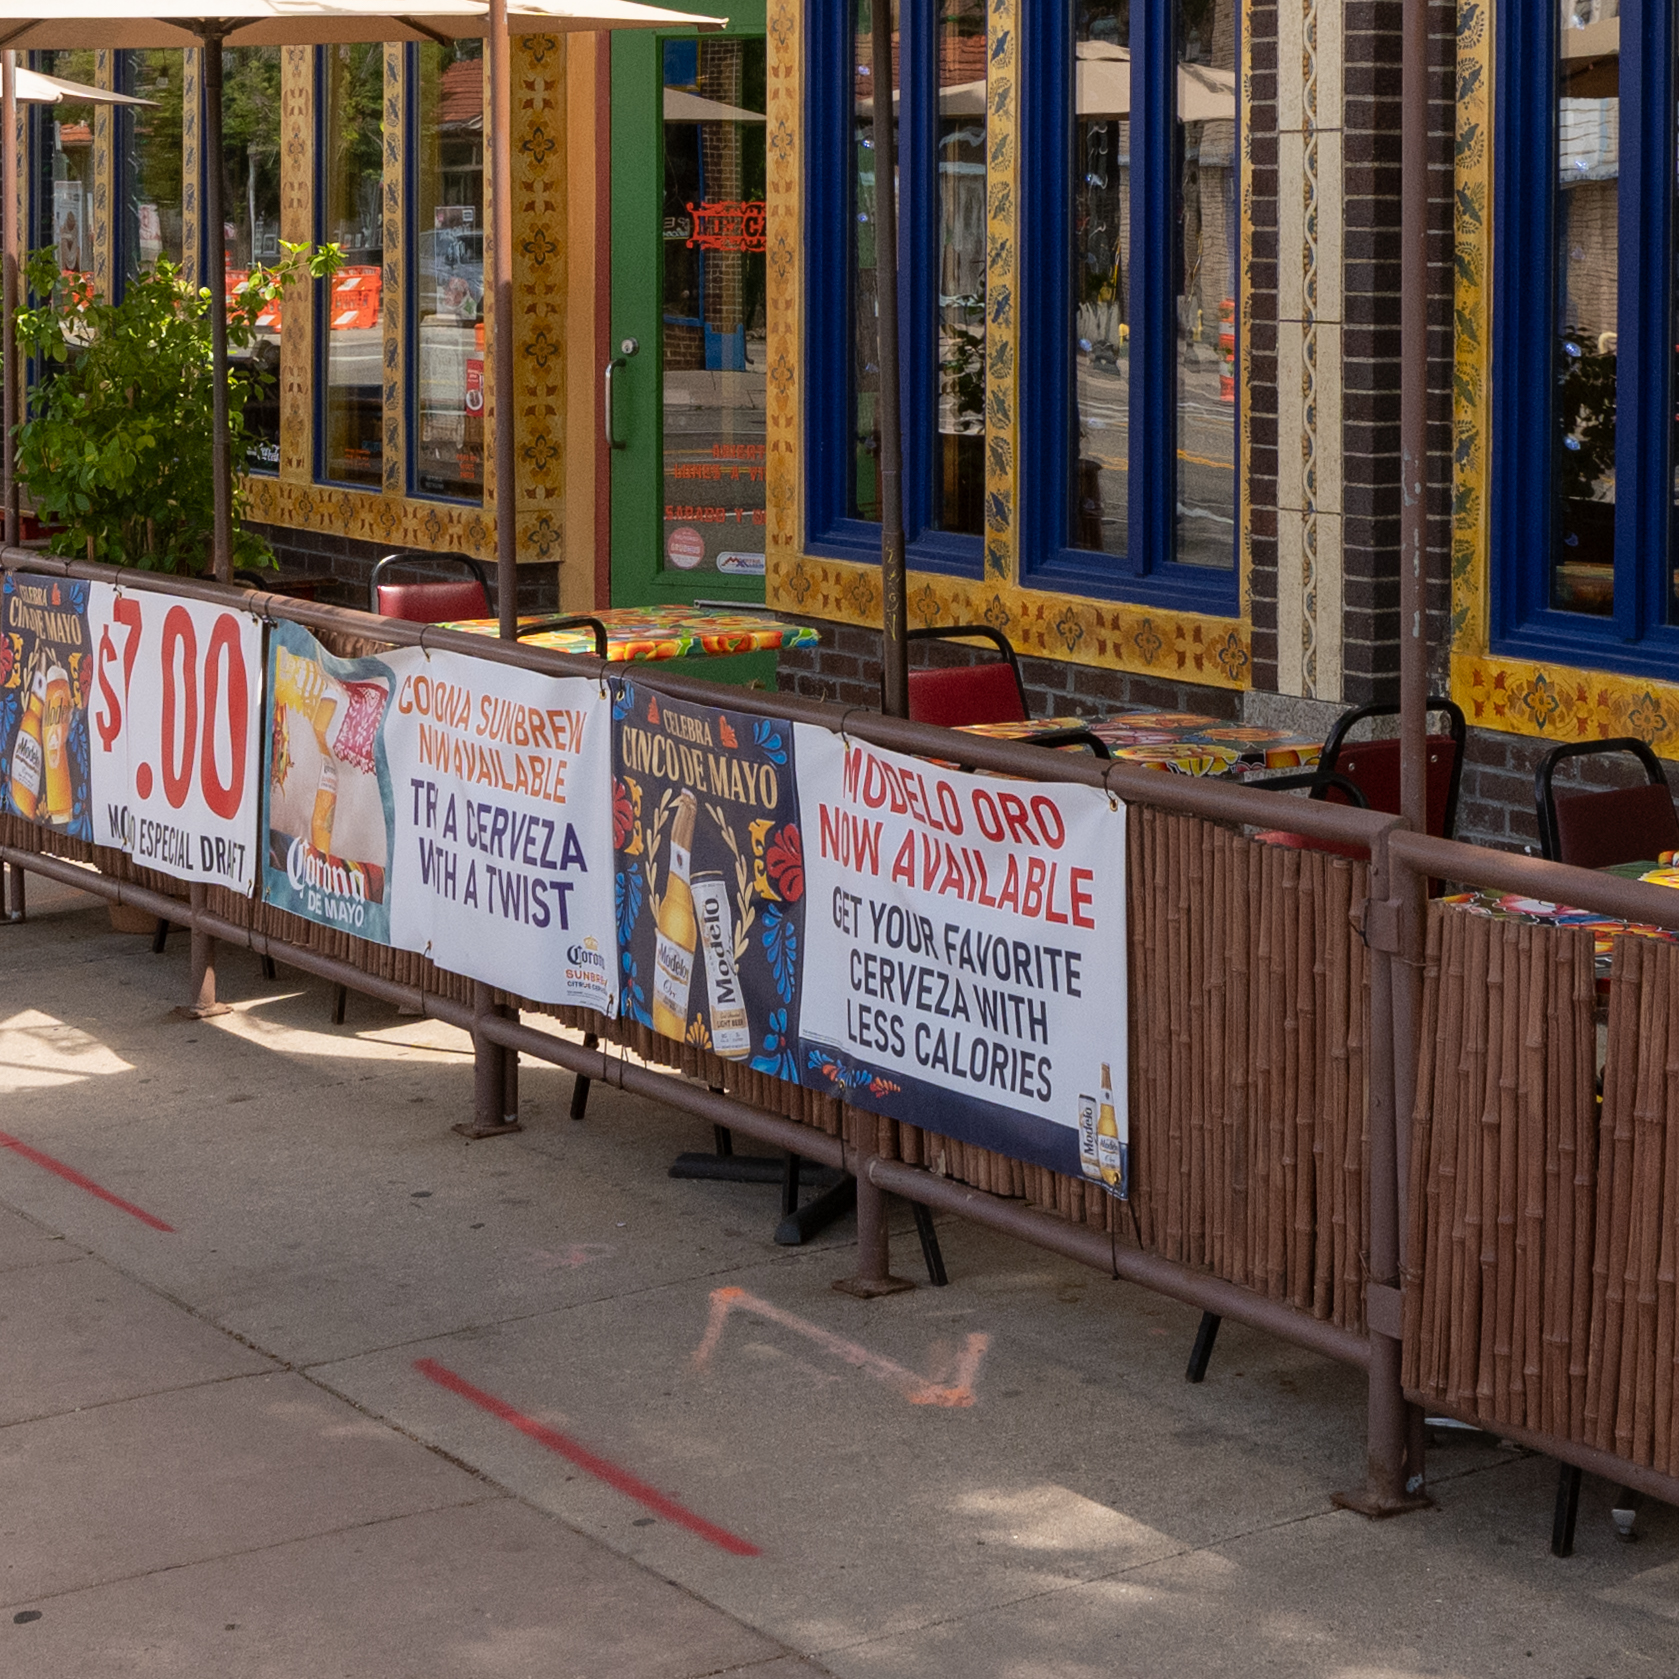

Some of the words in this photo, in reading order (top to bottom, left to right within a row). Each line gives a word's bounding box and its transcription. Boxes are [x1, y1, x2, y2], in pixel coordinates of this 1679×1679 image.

[44, 611, 82, 645] MAYO
[95, 596, 249, 820] $7.00
[475, 694, 588, 755] SUNBREW
[663, 709, 713, 747] CELEBRA
[453, 737, 568, 804] AVAILABLE
[622, 724, 680, 783] CINCO
[679, 743, 707, 793] DE
[707, 752, 778, 810] MAYO
[844, 747, 964, 837] MODELO
[972, 788, 1065, 850] ORO
[140, 818, 193, 871] ESPECIAL
[200, 835, 246, 883] DRAFT
[286, 835, 365, 905] Corona
[443, 792, 458, 843] A
[466, 798, 588, 873] CERVEZA
[819, 803, 883, 877] NOW
[891, 828, 1096, 930] AVAILABLE
[307, 889, 322, 916] DE
[324, 895, 364, 929] MAYO
[463, 858, 479, 910] A
[485, 863, 574, 932] TWIST
[703, 898, 735, 1004] Modelo
[832, 885, 862, 939] GET
[870, 899, 939, 961] YOUR
[944, 923, 1082, 999] FAVORITE
[849, 948, 970, 1023] CERVEZA
[973, 984, 1049, 1045] WITH
[846, 998, 905, 1059] LESS
[915, 1021, 1052, 1103] CALORIES
